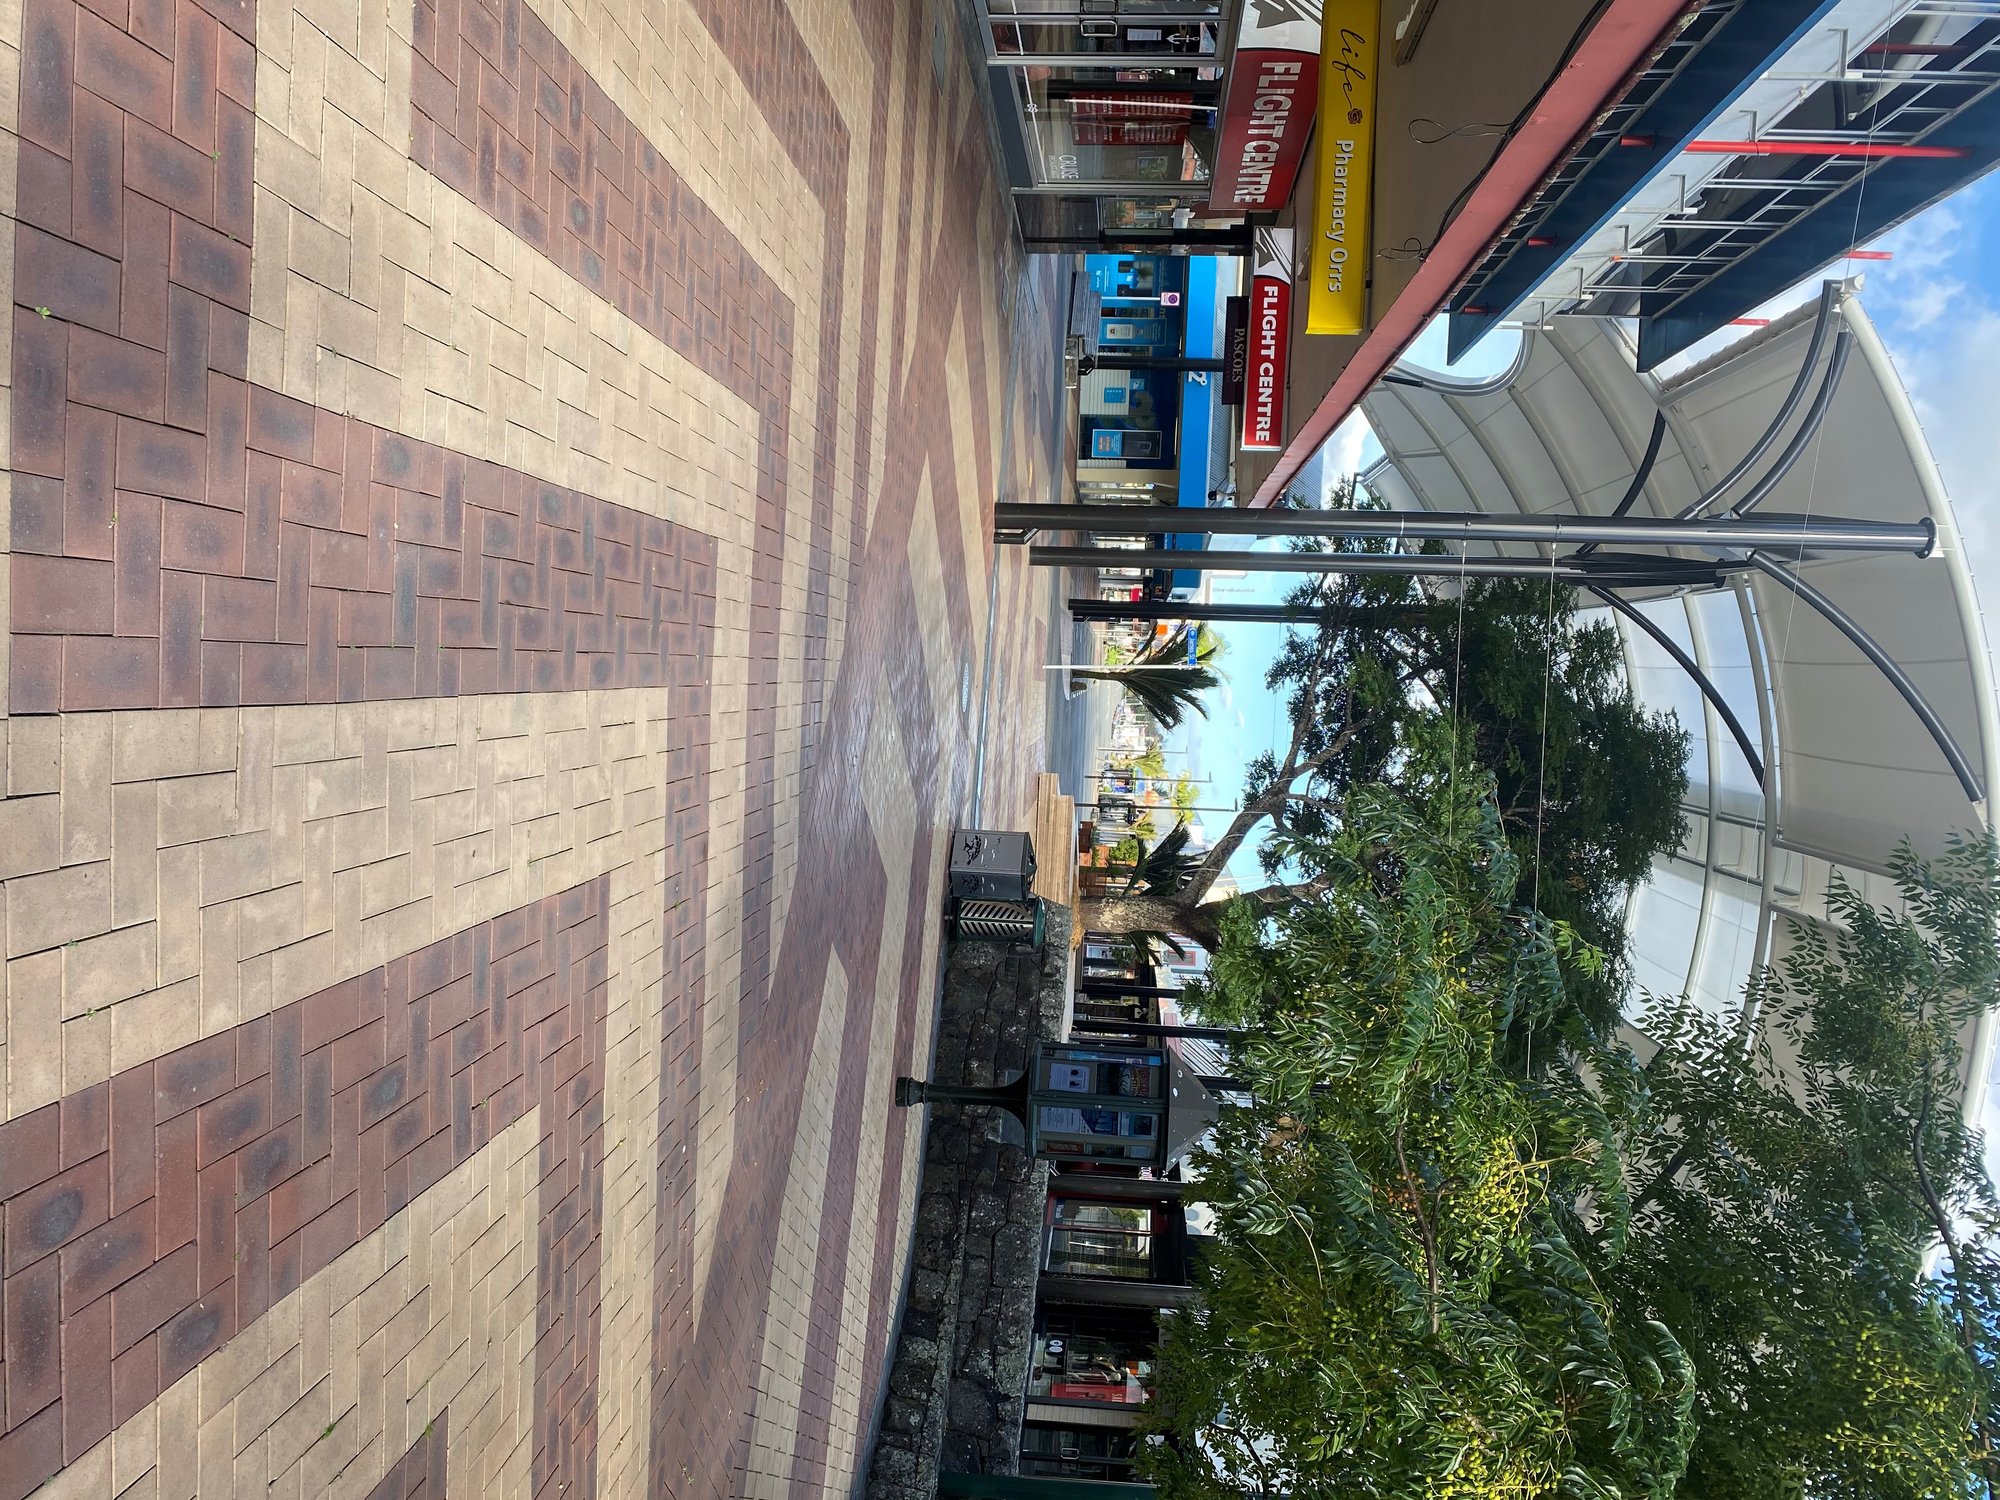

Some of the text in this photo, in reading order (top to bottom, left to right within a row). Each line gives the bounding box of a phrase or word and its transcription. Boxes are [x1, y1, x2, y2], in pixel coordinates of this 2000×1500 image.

[1332, 28, 1366, 107] life
[1058, 155, 1079, 179] CRUISE
[1233, 61, 1302, 203] FLIGHT CENTRE
[1326, 139, 1354, 292] Pharmacy Orrs
[1232, 328, 1245, 382] PASCOES
[1255, 286, 1278, 442] FLIGHT CENTRE
